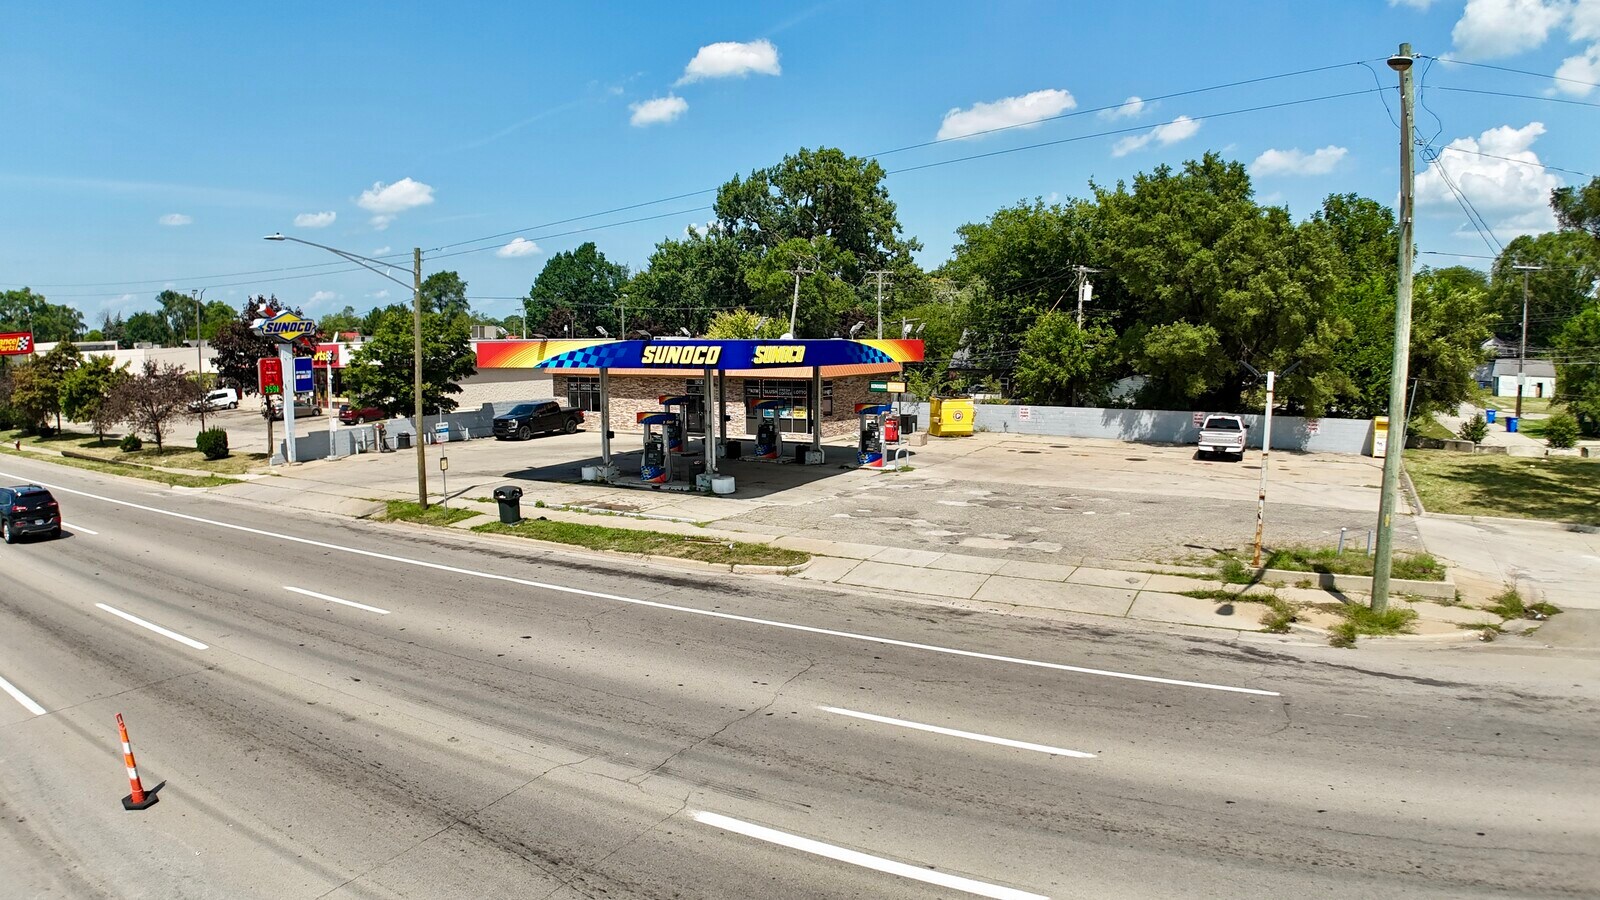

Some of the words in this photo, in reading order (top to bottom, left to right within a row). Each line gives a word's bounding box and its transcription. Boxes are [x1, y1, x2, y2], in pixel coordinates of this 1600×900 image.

[265, 322, 312, 333] SUNOCO
[641, 345, 721, 364] SUNOCO
[753, 345, 806, 364] SUNOCO
